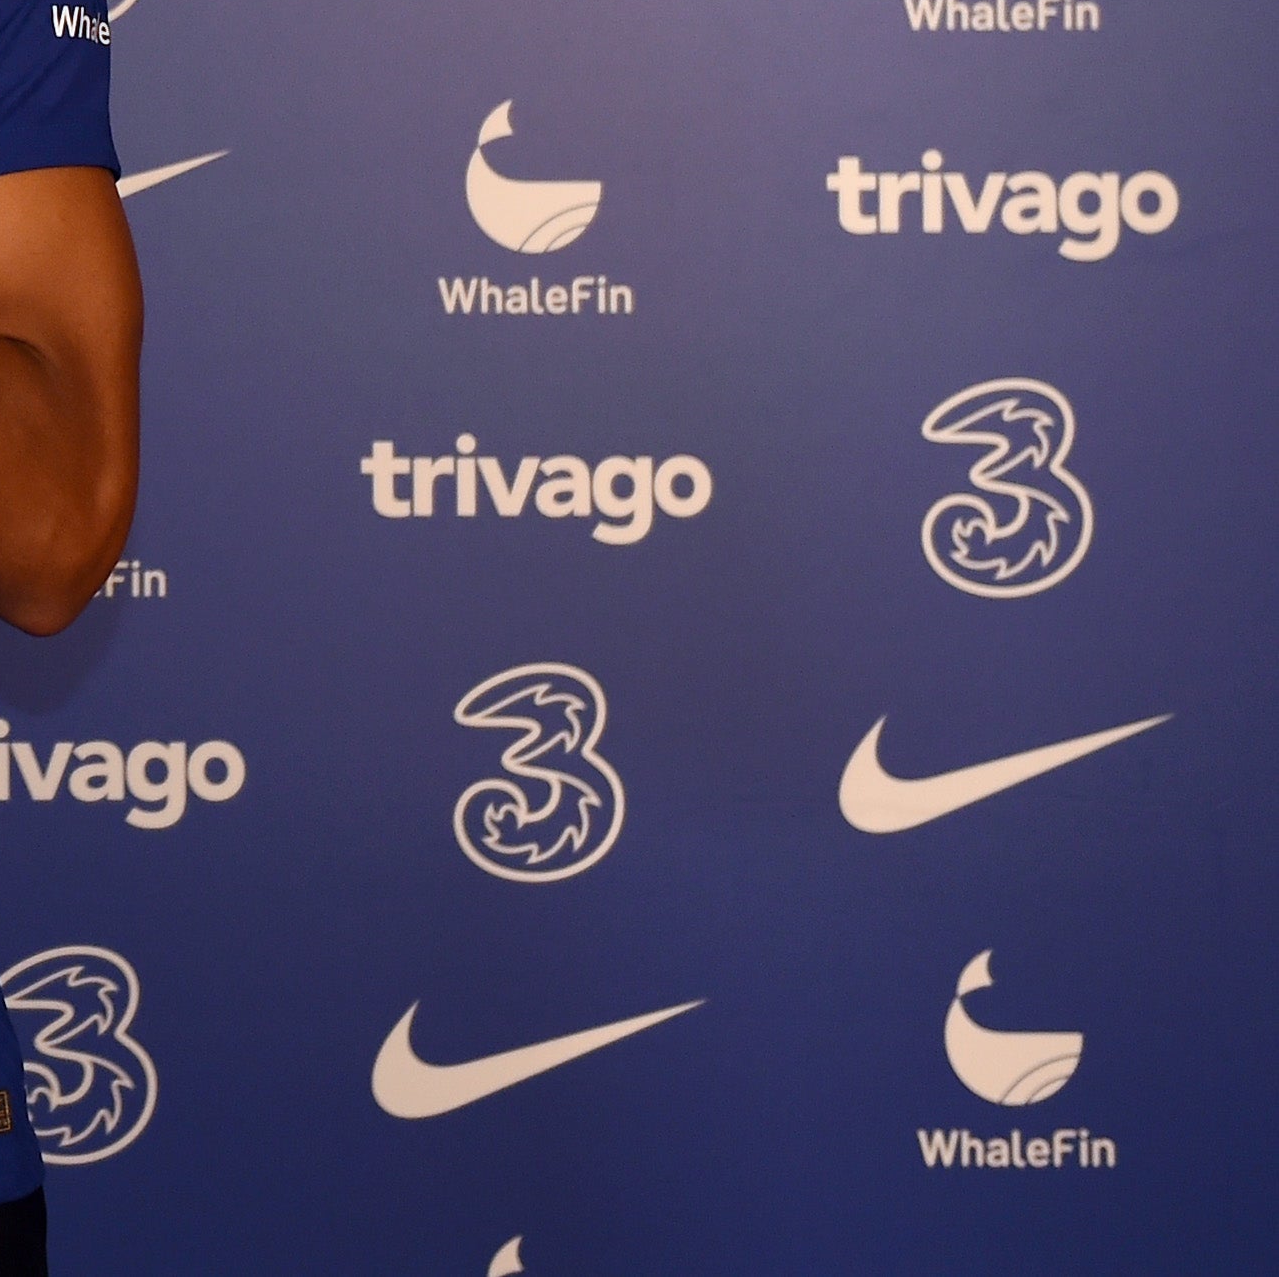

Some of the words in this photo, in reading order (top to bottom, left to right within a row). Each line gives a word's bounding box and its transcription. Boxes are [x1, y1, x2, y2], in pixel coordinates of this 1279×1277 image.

[826, 149, 1179, 261] trivago
[438, 276, 632, 314] WhaleFin
[360, 433, 713, 545] trivago
[921, 378, 1094, 598] 3
[453, 662, 625, 883] 3
[917, 1128, 1116, 1168] WhaleFin
